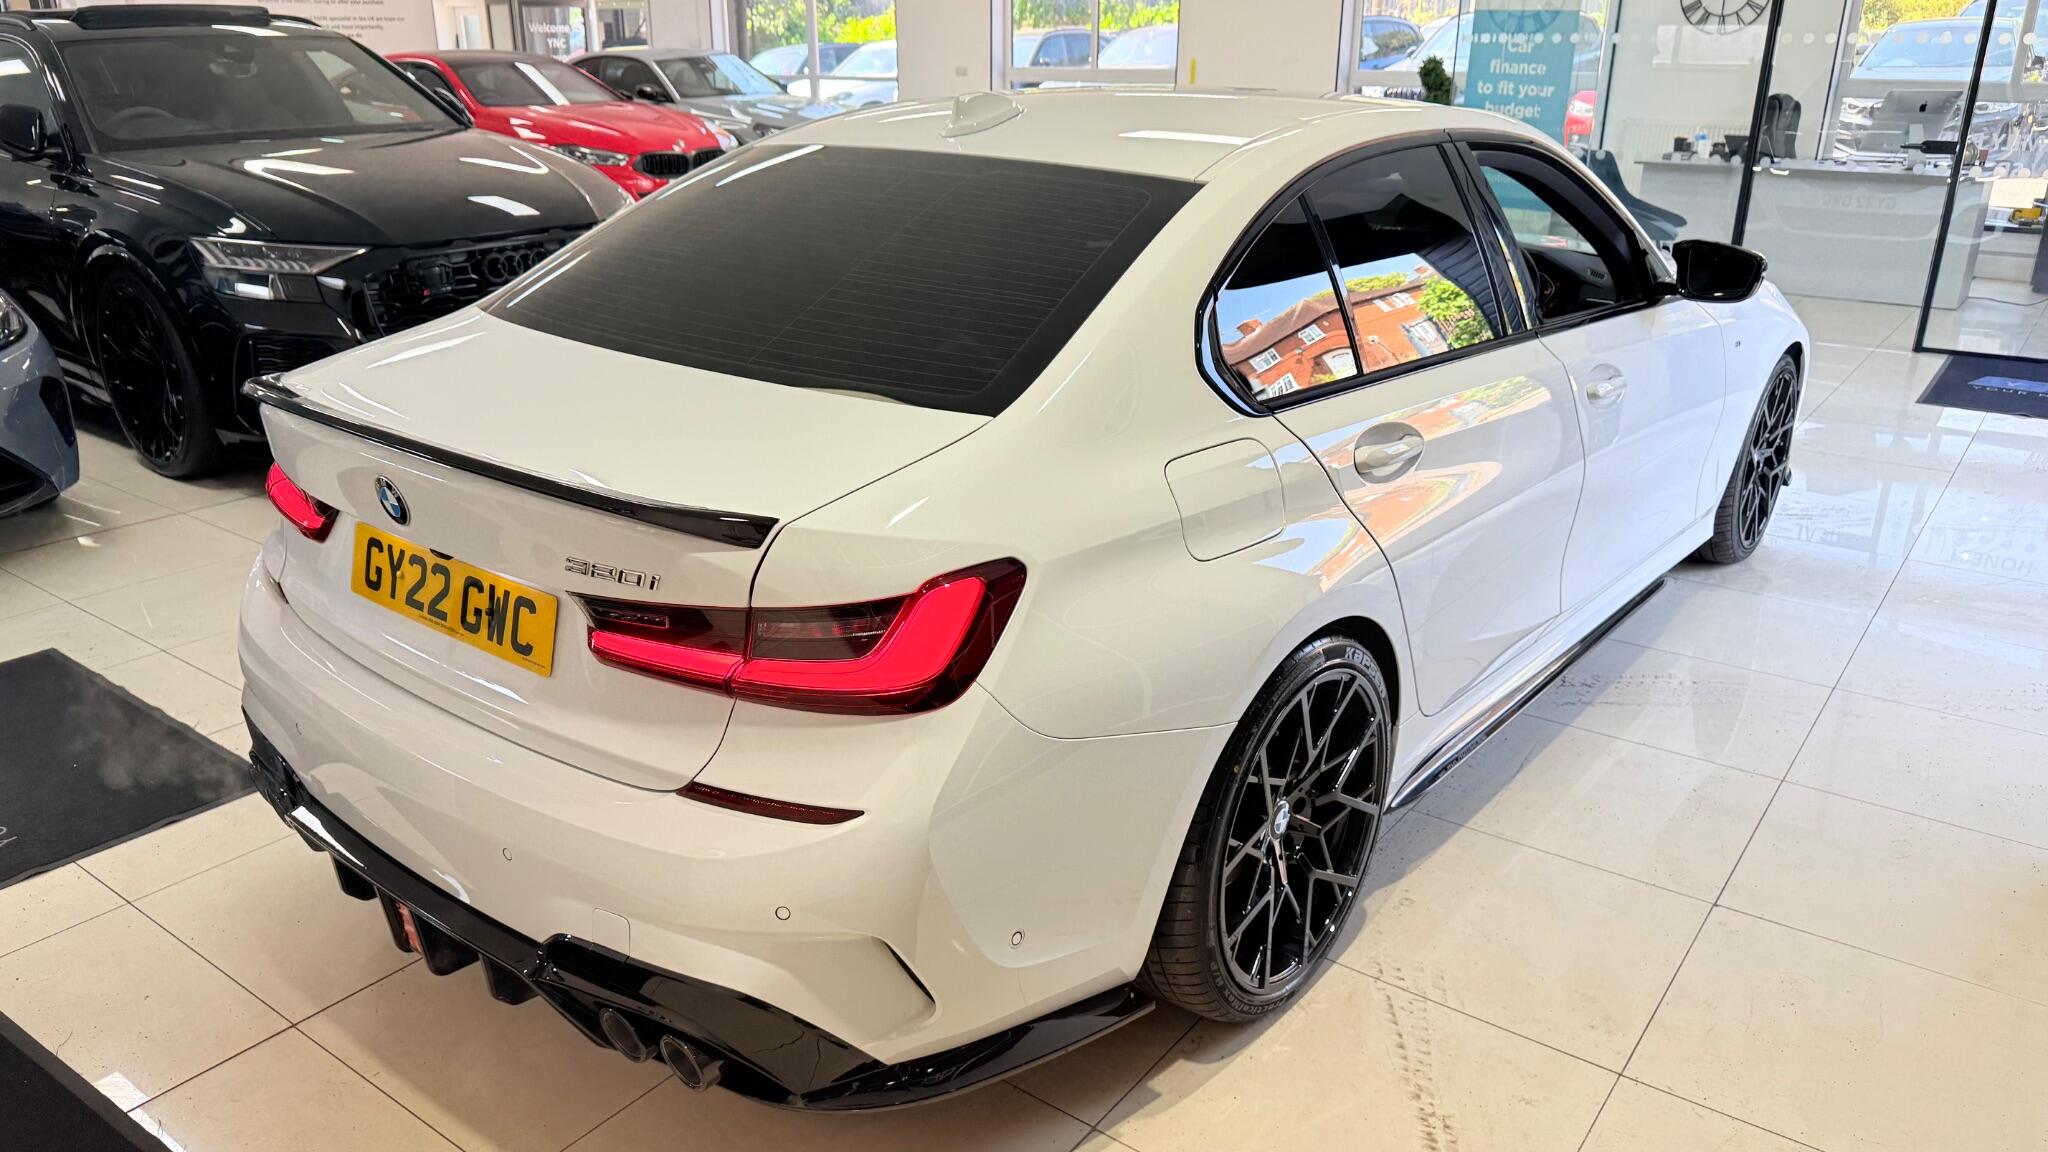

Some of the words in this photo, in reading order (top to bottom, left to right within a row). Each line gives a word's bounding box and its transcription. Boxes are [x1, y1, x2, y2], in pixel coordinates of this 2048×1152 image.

[528, 21, 570, 33] Welcome
[546, 37, 567, 48] YNC
[1507, 40, 1534, 53] Car
[1489, 58, 1547, 75] finance
[1477, 81, 1493, 94] to
[1498, 81, 1515, 96] fit
[1518, 84, 1555, 99] your
[365, 536, 453, 622] GY22
[460, 575, 537, 657] GWC
